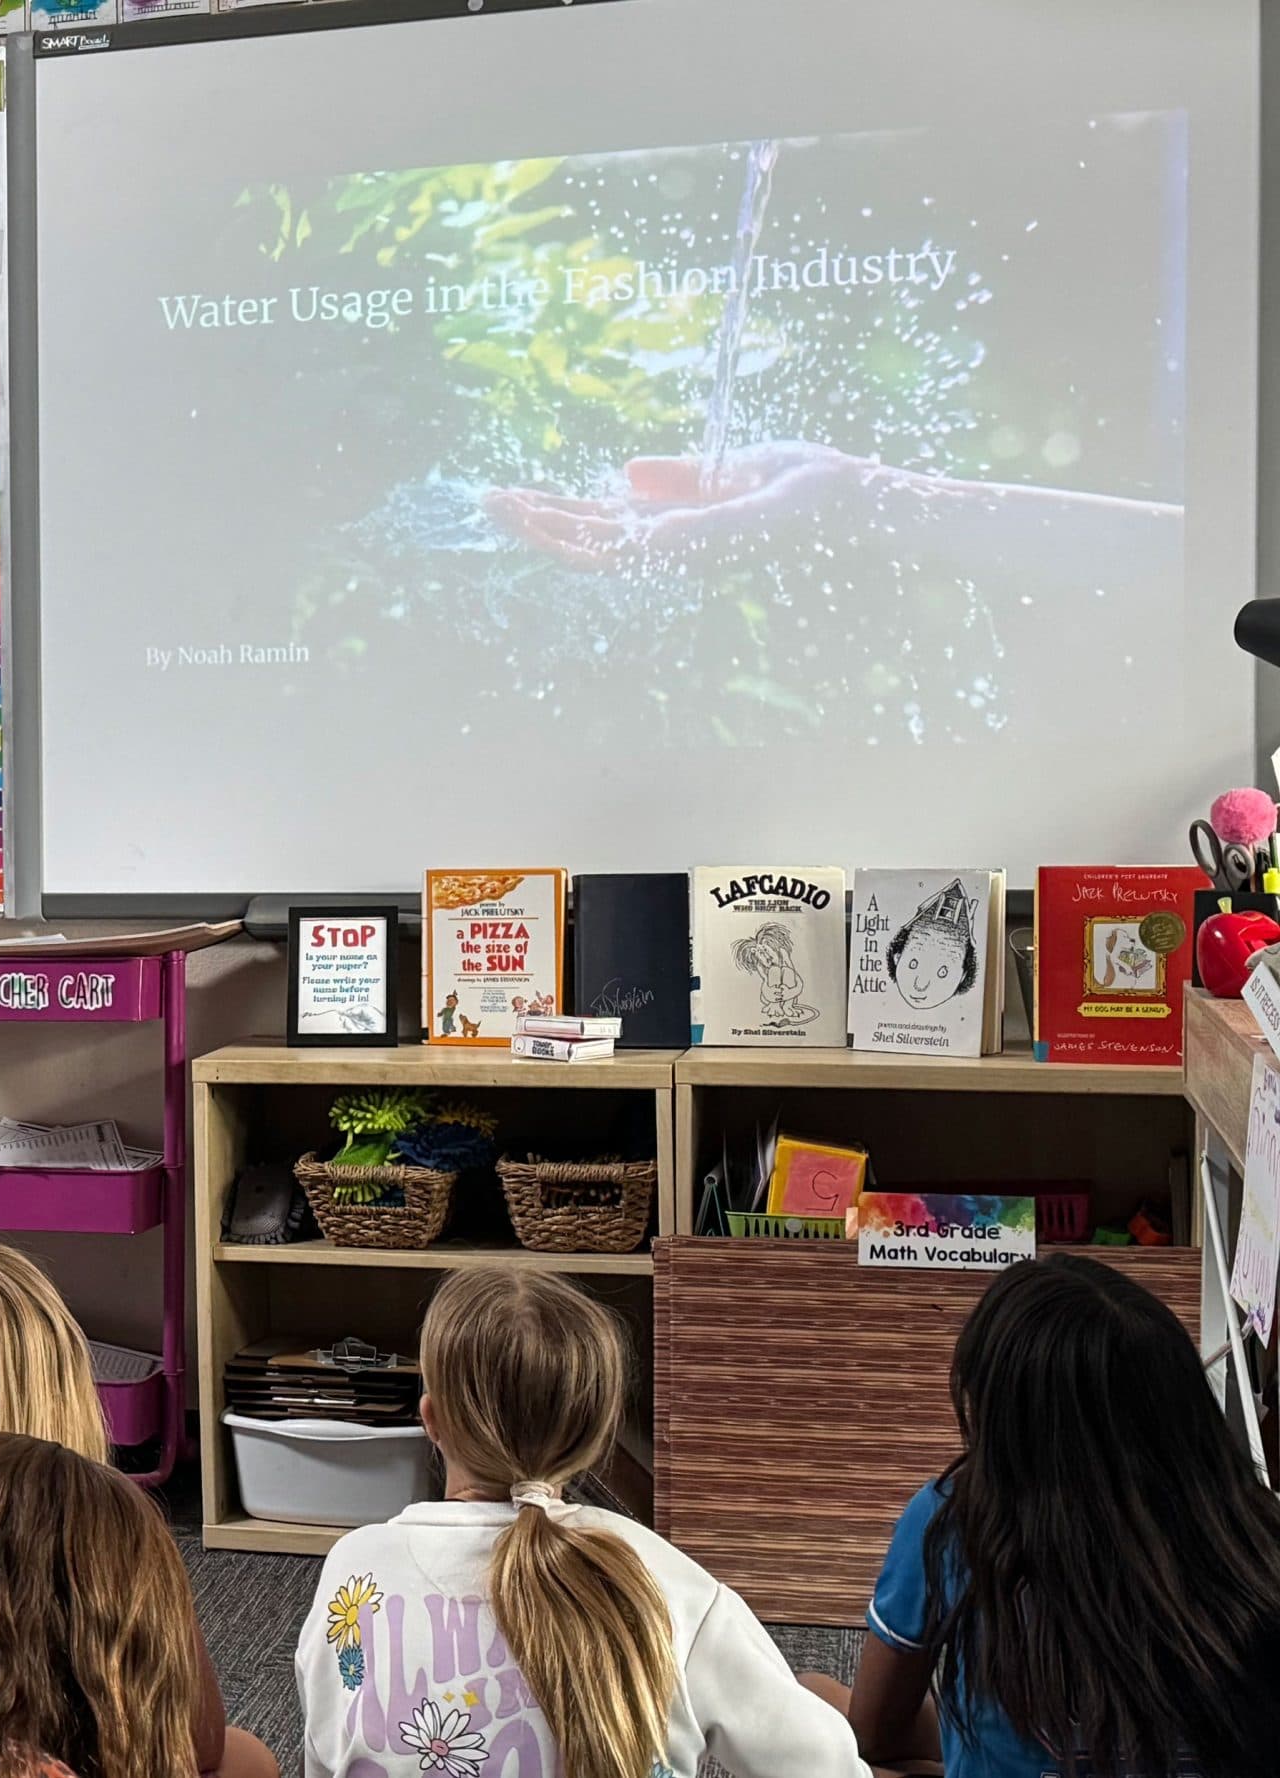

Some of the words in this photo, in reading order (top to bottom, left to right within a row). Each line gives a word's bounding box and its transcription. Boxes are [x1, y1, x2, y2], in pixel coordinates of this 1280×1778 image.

[158, 294, 278, 330] Water
[288, 285, 414, 328] Usage
[425, 277, 467, 313] in
[479, 269, 552, 309] the
[562, 260, 740, 304] Fashion
[752, 247, 958, 291] Industry
[146, 647, 171, 671] By
[178, 644, 232, 665] Noah
[240, 642, 309, 663] Ramin
[710, 874, 831, 910] LAFCADIO
[867, 893, 879, 911] A
[461, 908, 480, 917] JACK
[482, 908, 525, 916] PRELUTSKY
[456, 929, 464, 939] a
[470, 922, 530, 939] PIZZA
[856, 914, 890, 936] Light
[311, 925, 376, 948] STOP
[864, 937, 878, 953] in
[461, 942, 481, 953] the
[485, 941, 510, 953] size
[515, 940, 528, 955] of
[462, 959, 482, 972] the
[487, 955, 524, 972] SUN
[859, 955, 882, 972] the
[58, 972, 115, 1010] CART
[853, 975, 887, 993] Attic
[872, 1031, 894, 1043] Shel
[896, 1033, 950, 1047] Silverstein
[893, 1220, 930, 1238] 3rd
[937, 1222, 1001, 1240] Grade
[870, 1244, 917, 1261] Math
[925, 1246, 1032, 1264] Vocabulary
